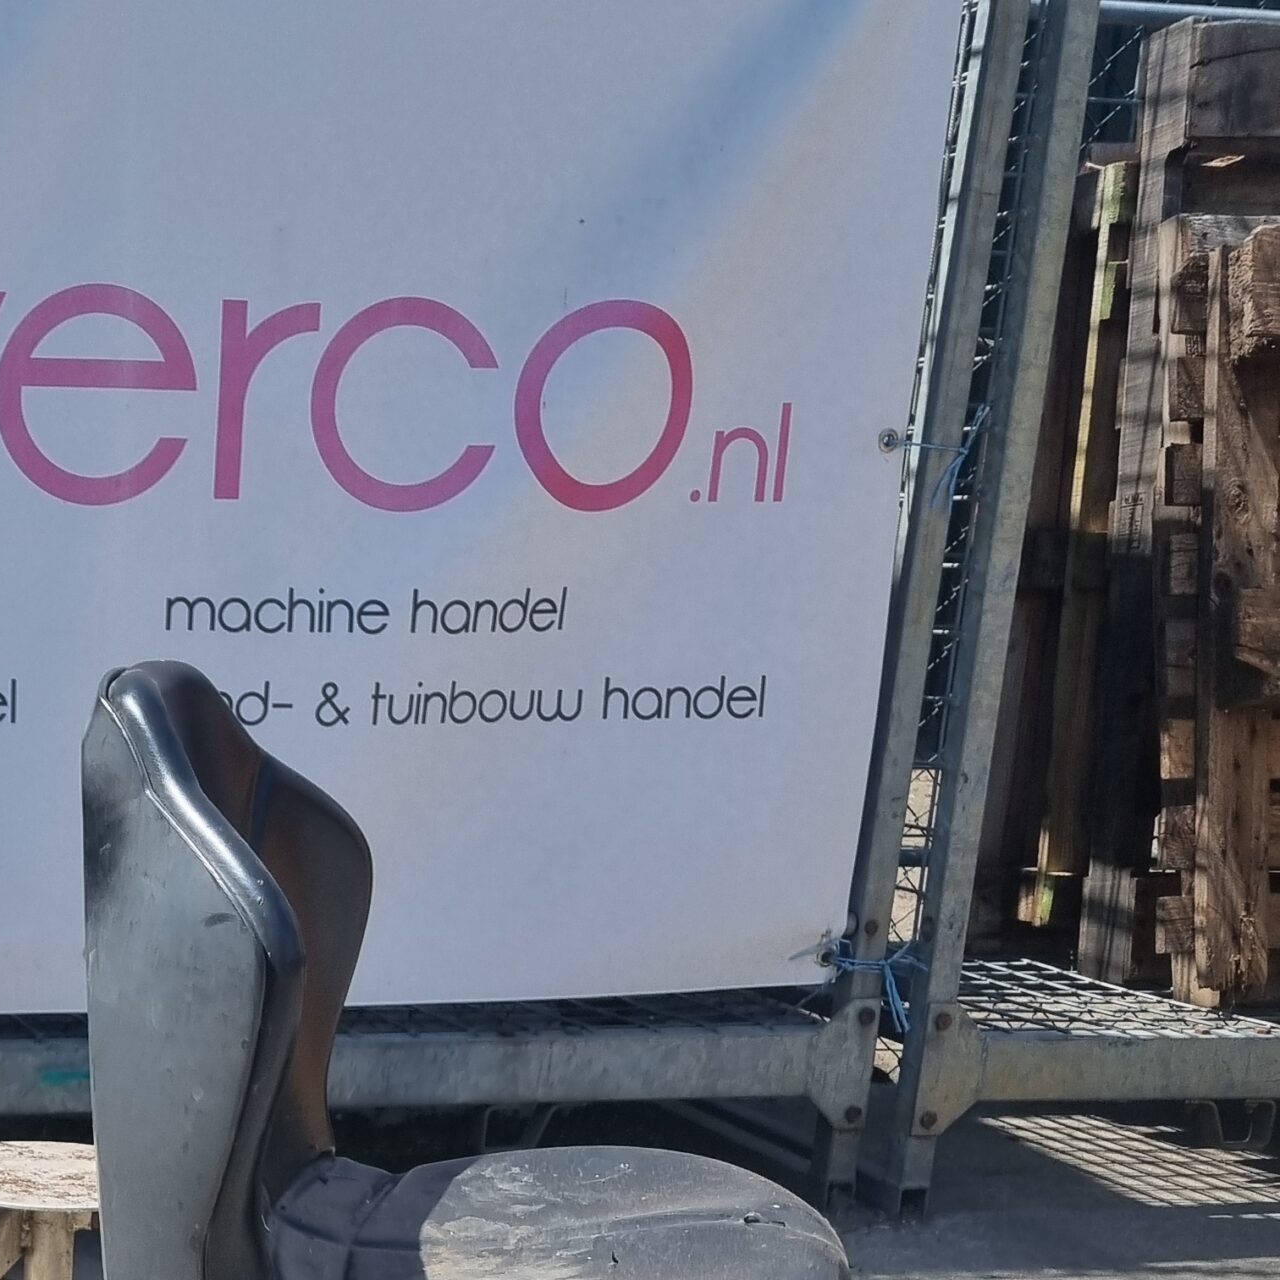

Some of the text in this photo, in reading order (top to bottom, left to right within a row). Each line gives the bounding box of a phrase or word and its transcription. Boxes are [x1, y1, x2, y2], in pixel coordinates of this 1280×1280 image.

[165, 586, 568, 636] machine handel
[314, 681, 351, 728] &
[370, 680, 584, 726] tuinbouw
[601, 674, 767, 720] handel
